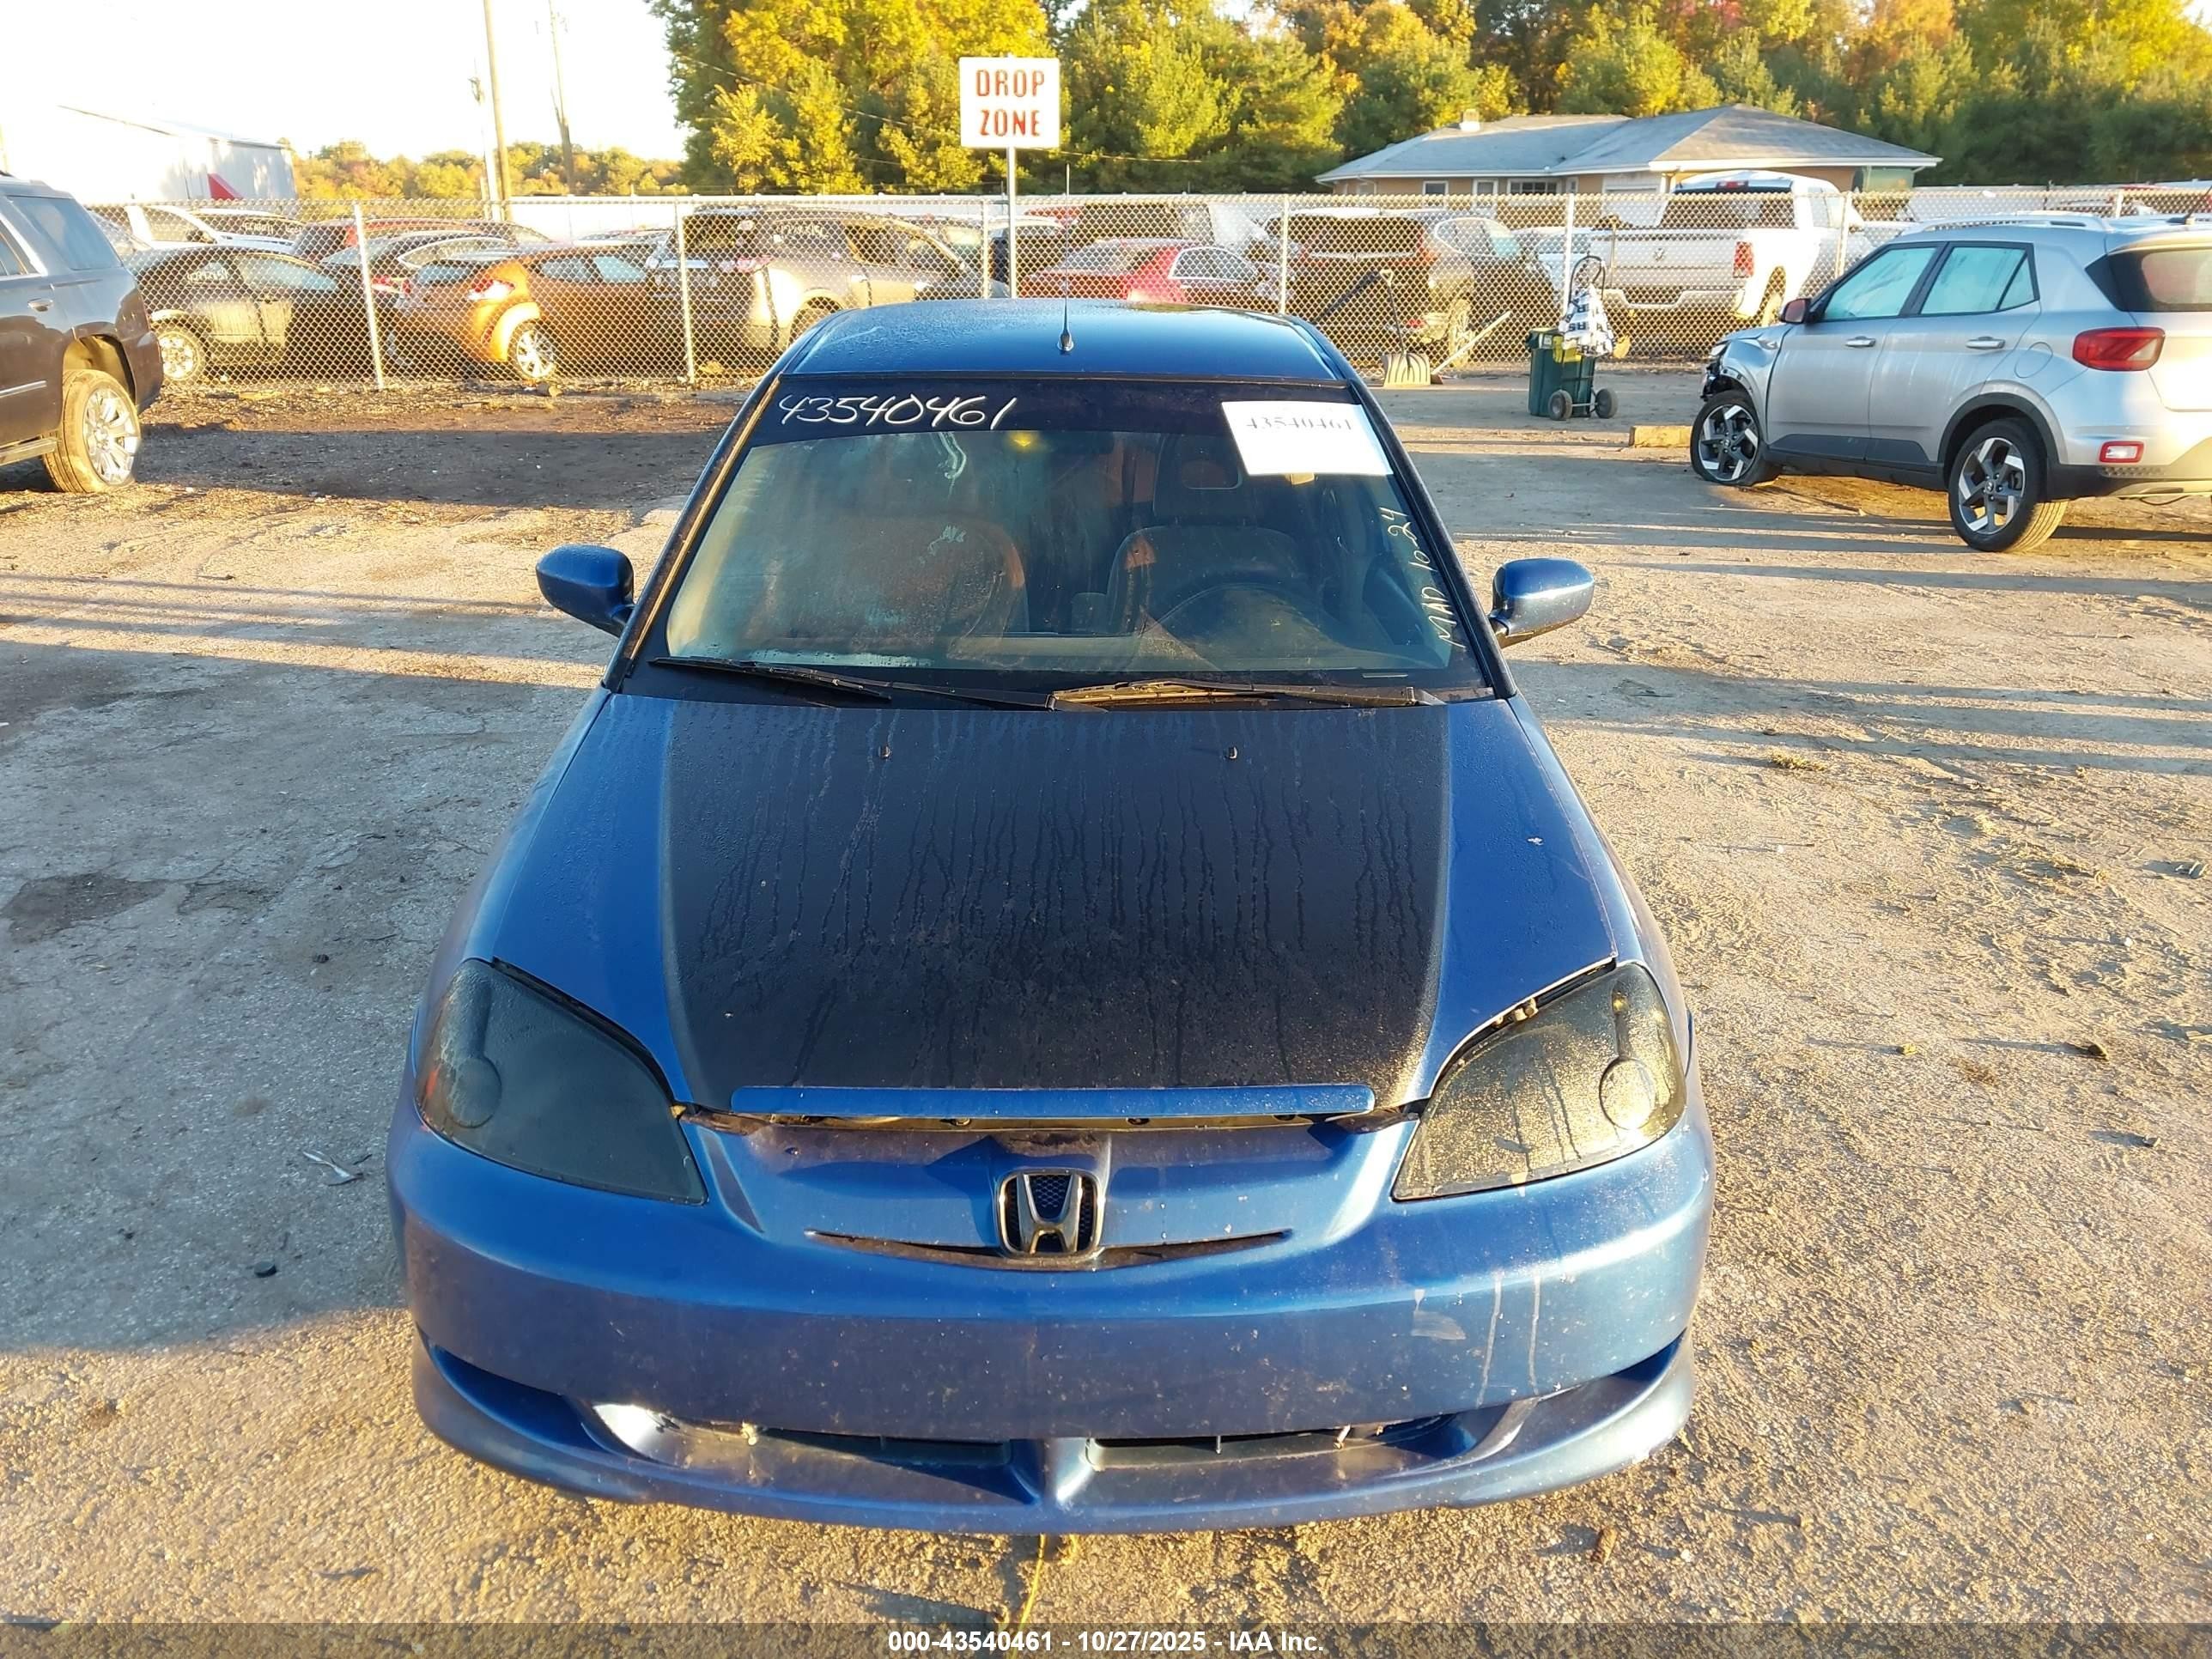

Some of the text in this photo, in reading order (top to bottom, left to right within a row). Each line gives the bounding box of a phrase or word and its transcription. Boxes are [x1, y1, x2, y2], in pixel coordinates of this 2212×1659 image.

[975, 69, 1045, 98] DROP
[979, 109, 1041, 137] ZONE
[779, 393, 1018, 430] 43540461
[1246, 416, 1352, 431] 43540461
[1421, 586, 1468, 650] MAD
